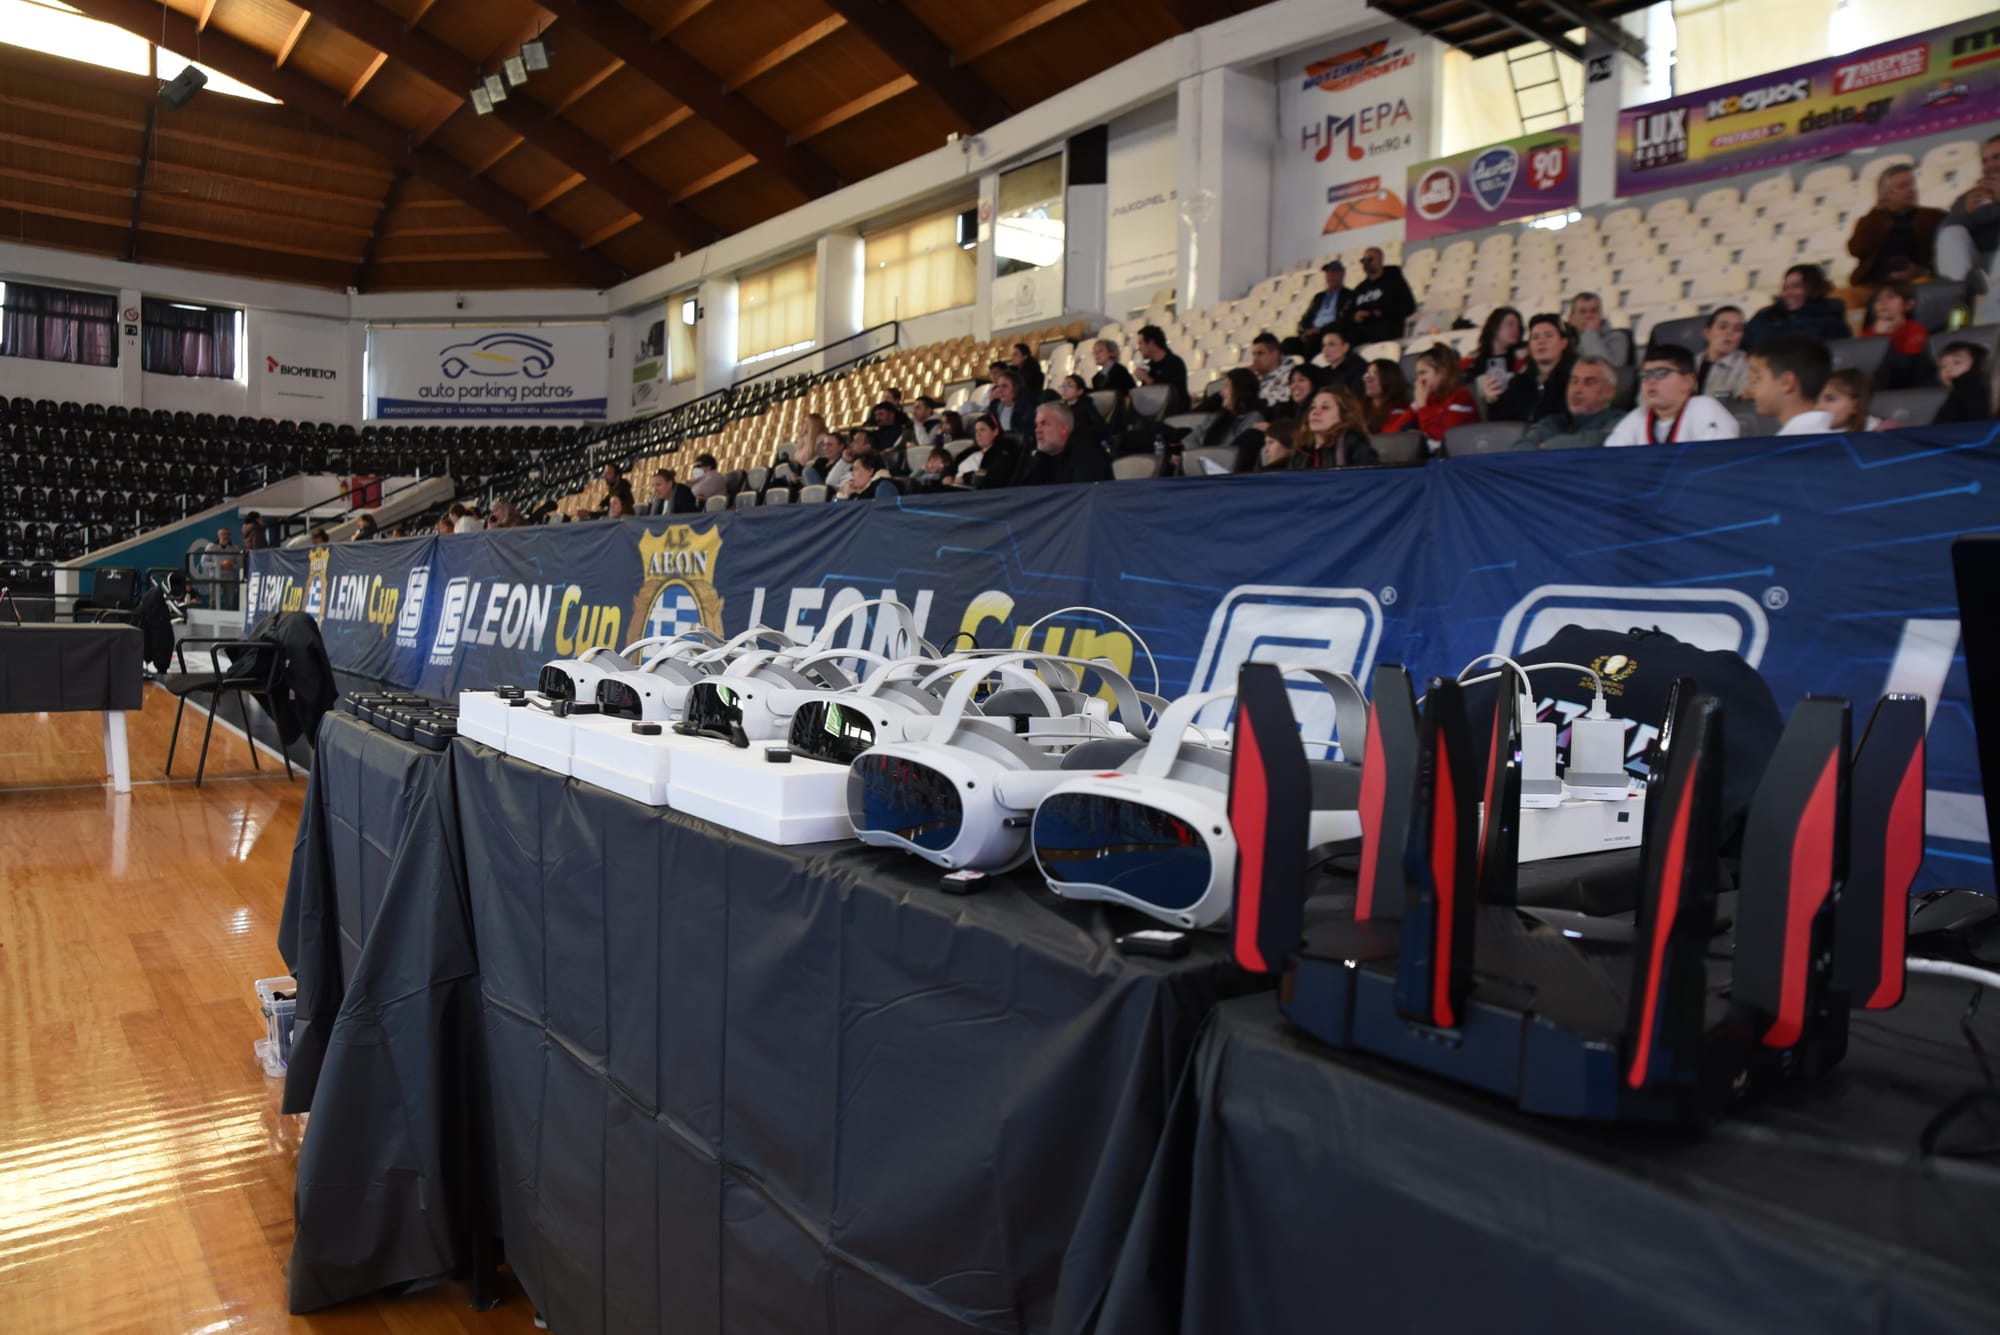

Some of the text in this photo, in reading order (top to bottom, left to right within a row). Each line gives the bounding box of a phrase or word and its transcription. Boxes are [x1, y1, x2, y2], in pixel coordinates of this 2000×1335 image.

[1636, 108, 1688, 149] LUX
[1532, 148, 1562, 181] 90
[418, 381, 574, 402] auto parking patras
[327, 574, 399, 638] LEON Cup
[461, 582, 622, 657] LEON Cup
